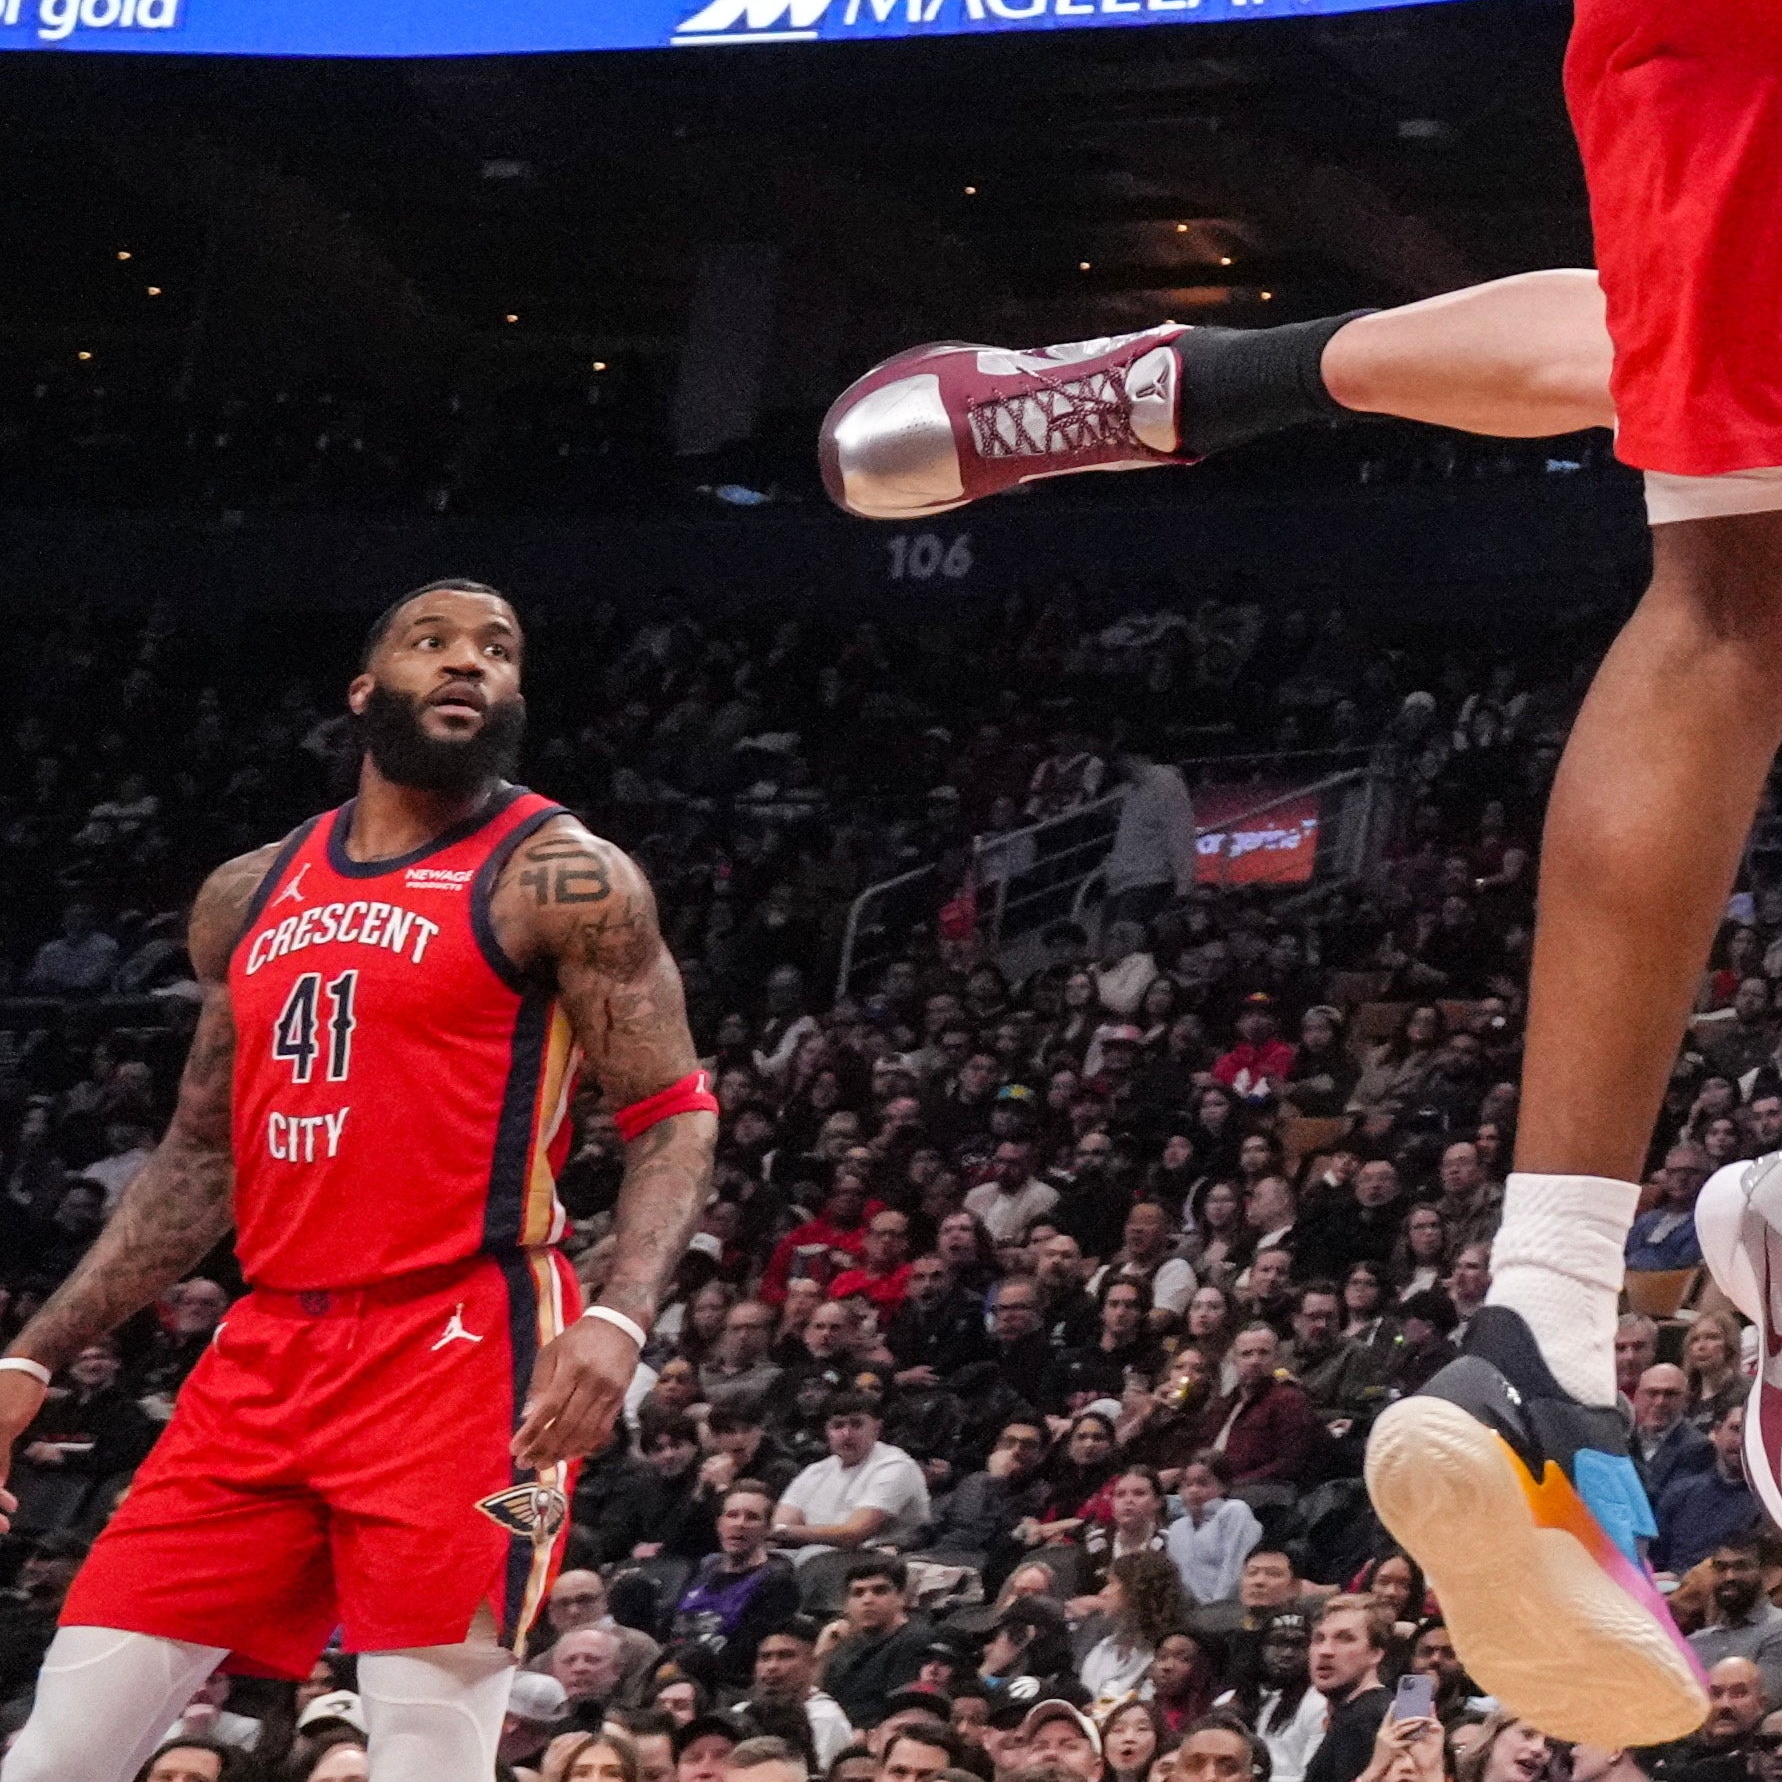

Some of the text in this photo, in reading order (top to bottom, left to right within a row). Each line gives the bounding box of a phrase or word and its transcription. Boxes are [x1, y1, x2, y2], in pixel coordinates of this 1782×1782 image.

[887, 531, 974, 581] 106
[404, 868, 475, 883] NEWAGE
[245, 901, 440, 976] CRESCENT
[273, 969, 358, 1085] 41
[266, 1106, 350, 1164] CITY
